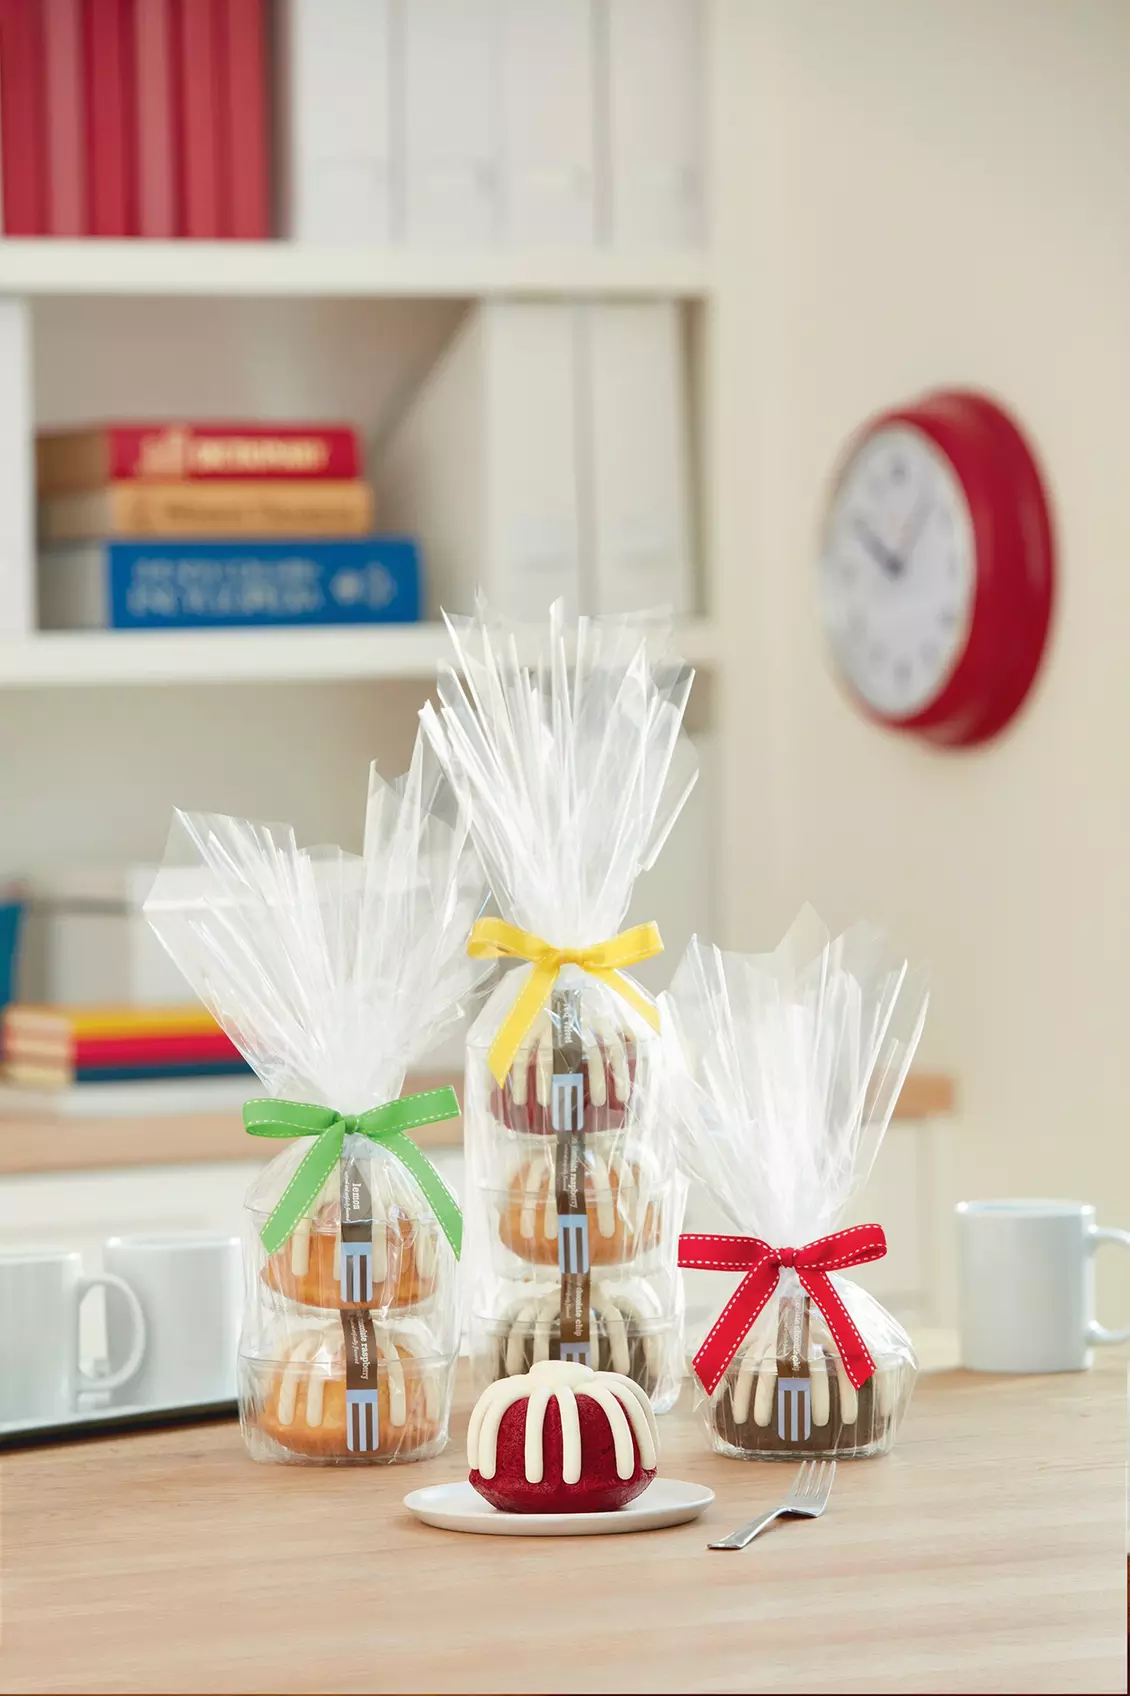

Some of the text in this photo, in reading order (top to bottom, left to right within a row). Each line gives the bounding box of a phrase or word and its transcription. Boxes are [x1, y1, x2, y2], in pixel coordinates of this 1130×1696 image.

[352, 1183, 361, 1210] lemon
[569, 1173, 578, 1208] raspberry
[574, 1319, 583, 1336] chip
[360, 1343, 370, 1380] raspberry
